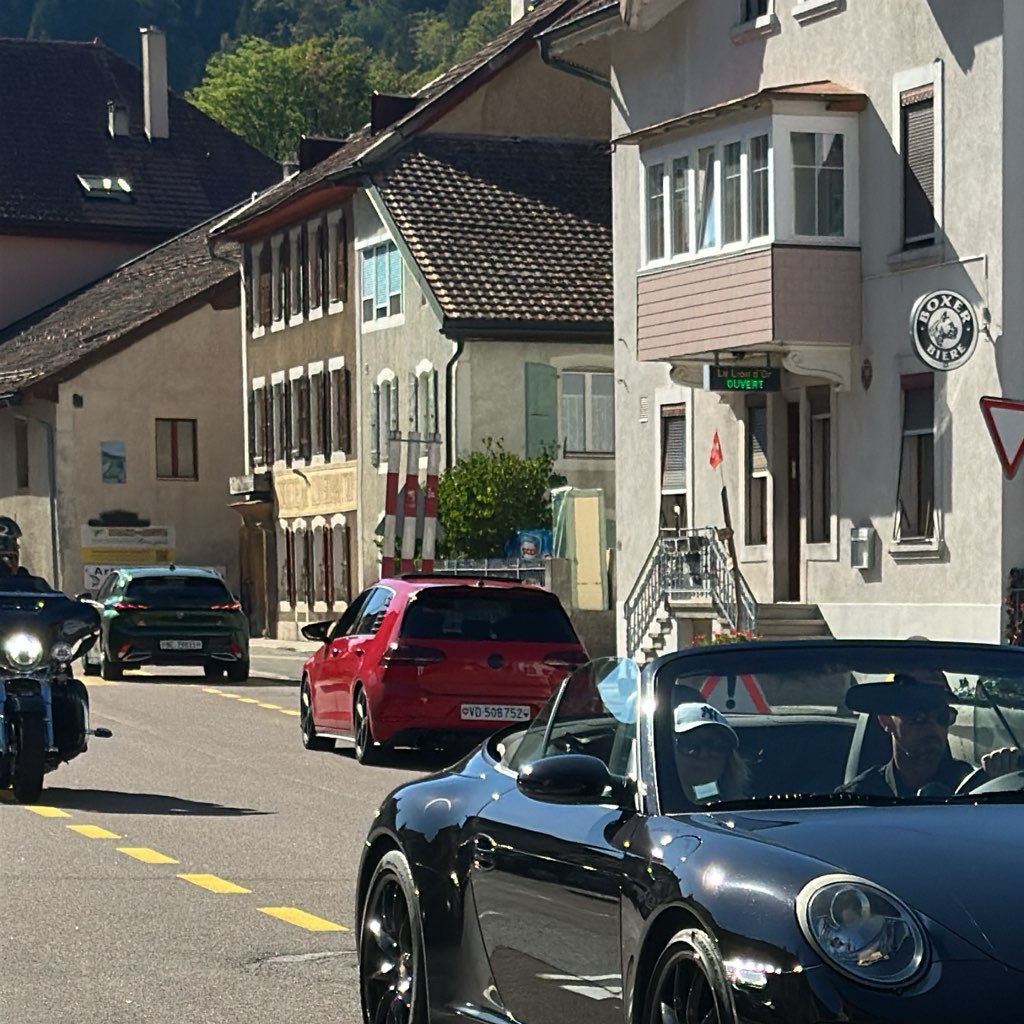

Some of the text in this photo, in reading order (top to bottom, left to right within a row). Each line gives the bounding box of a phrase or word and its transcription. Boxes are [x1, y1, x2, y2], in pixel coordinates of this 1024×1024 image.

[919, 295, 971, 323] BOXER
[727, 379, 764, 389] OUVERT
[469, 706, 523, 719] VD 508752
